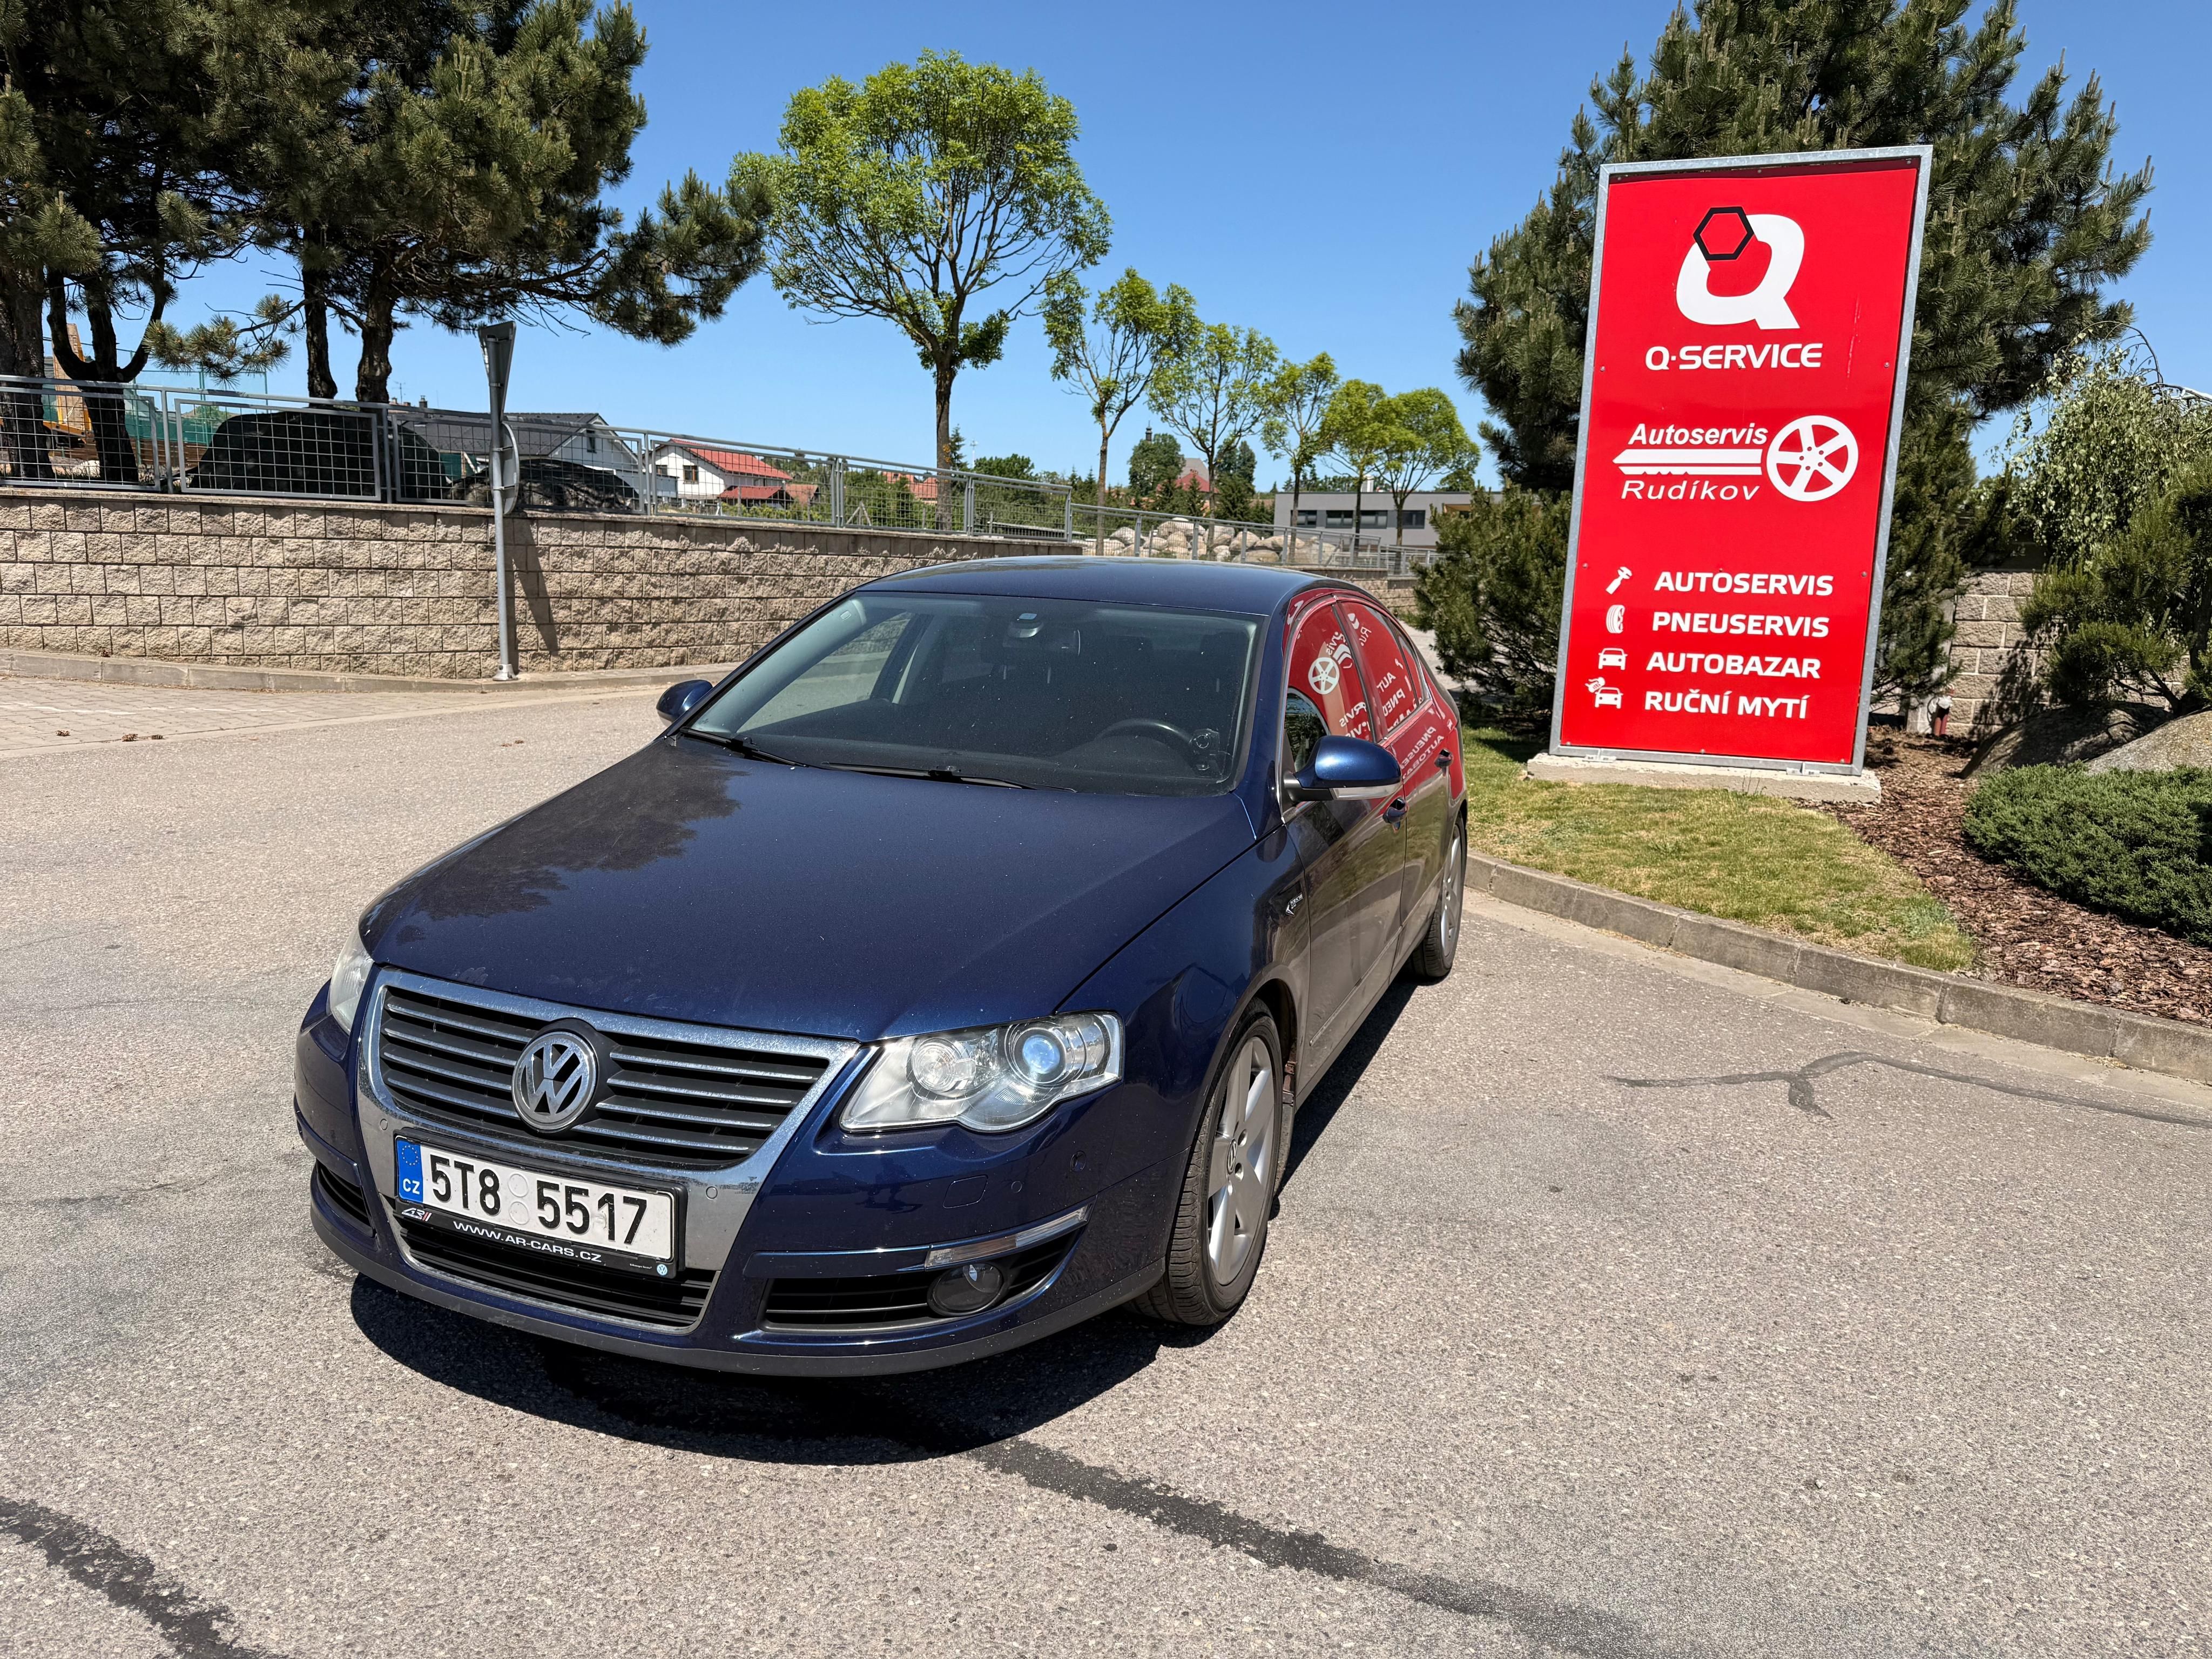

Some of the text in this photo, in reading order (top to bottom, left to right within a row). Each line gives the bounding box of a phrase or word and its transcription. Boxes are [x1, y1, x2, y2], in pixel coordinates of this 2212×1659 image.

[1628, 422, 1769, 446] Autoservis
[1621, 480, 1760, 500] Rudíkov
[1654, 571, 1833, 596] AUTOSERVIS
[1653, 611, 1830, 638] PNEUSERVIS
[1646, 652, 1820, 679] AUTOBAZAR
[1644, 689, 1810, 719] RUČNÍ MYTÍ
[403, 1178, 420, 1195] CZ
[430, 1154, 648, 1244] 5T8 5517
[453, 1220, 602, 1263] WWW.AR-CARS.CZ
